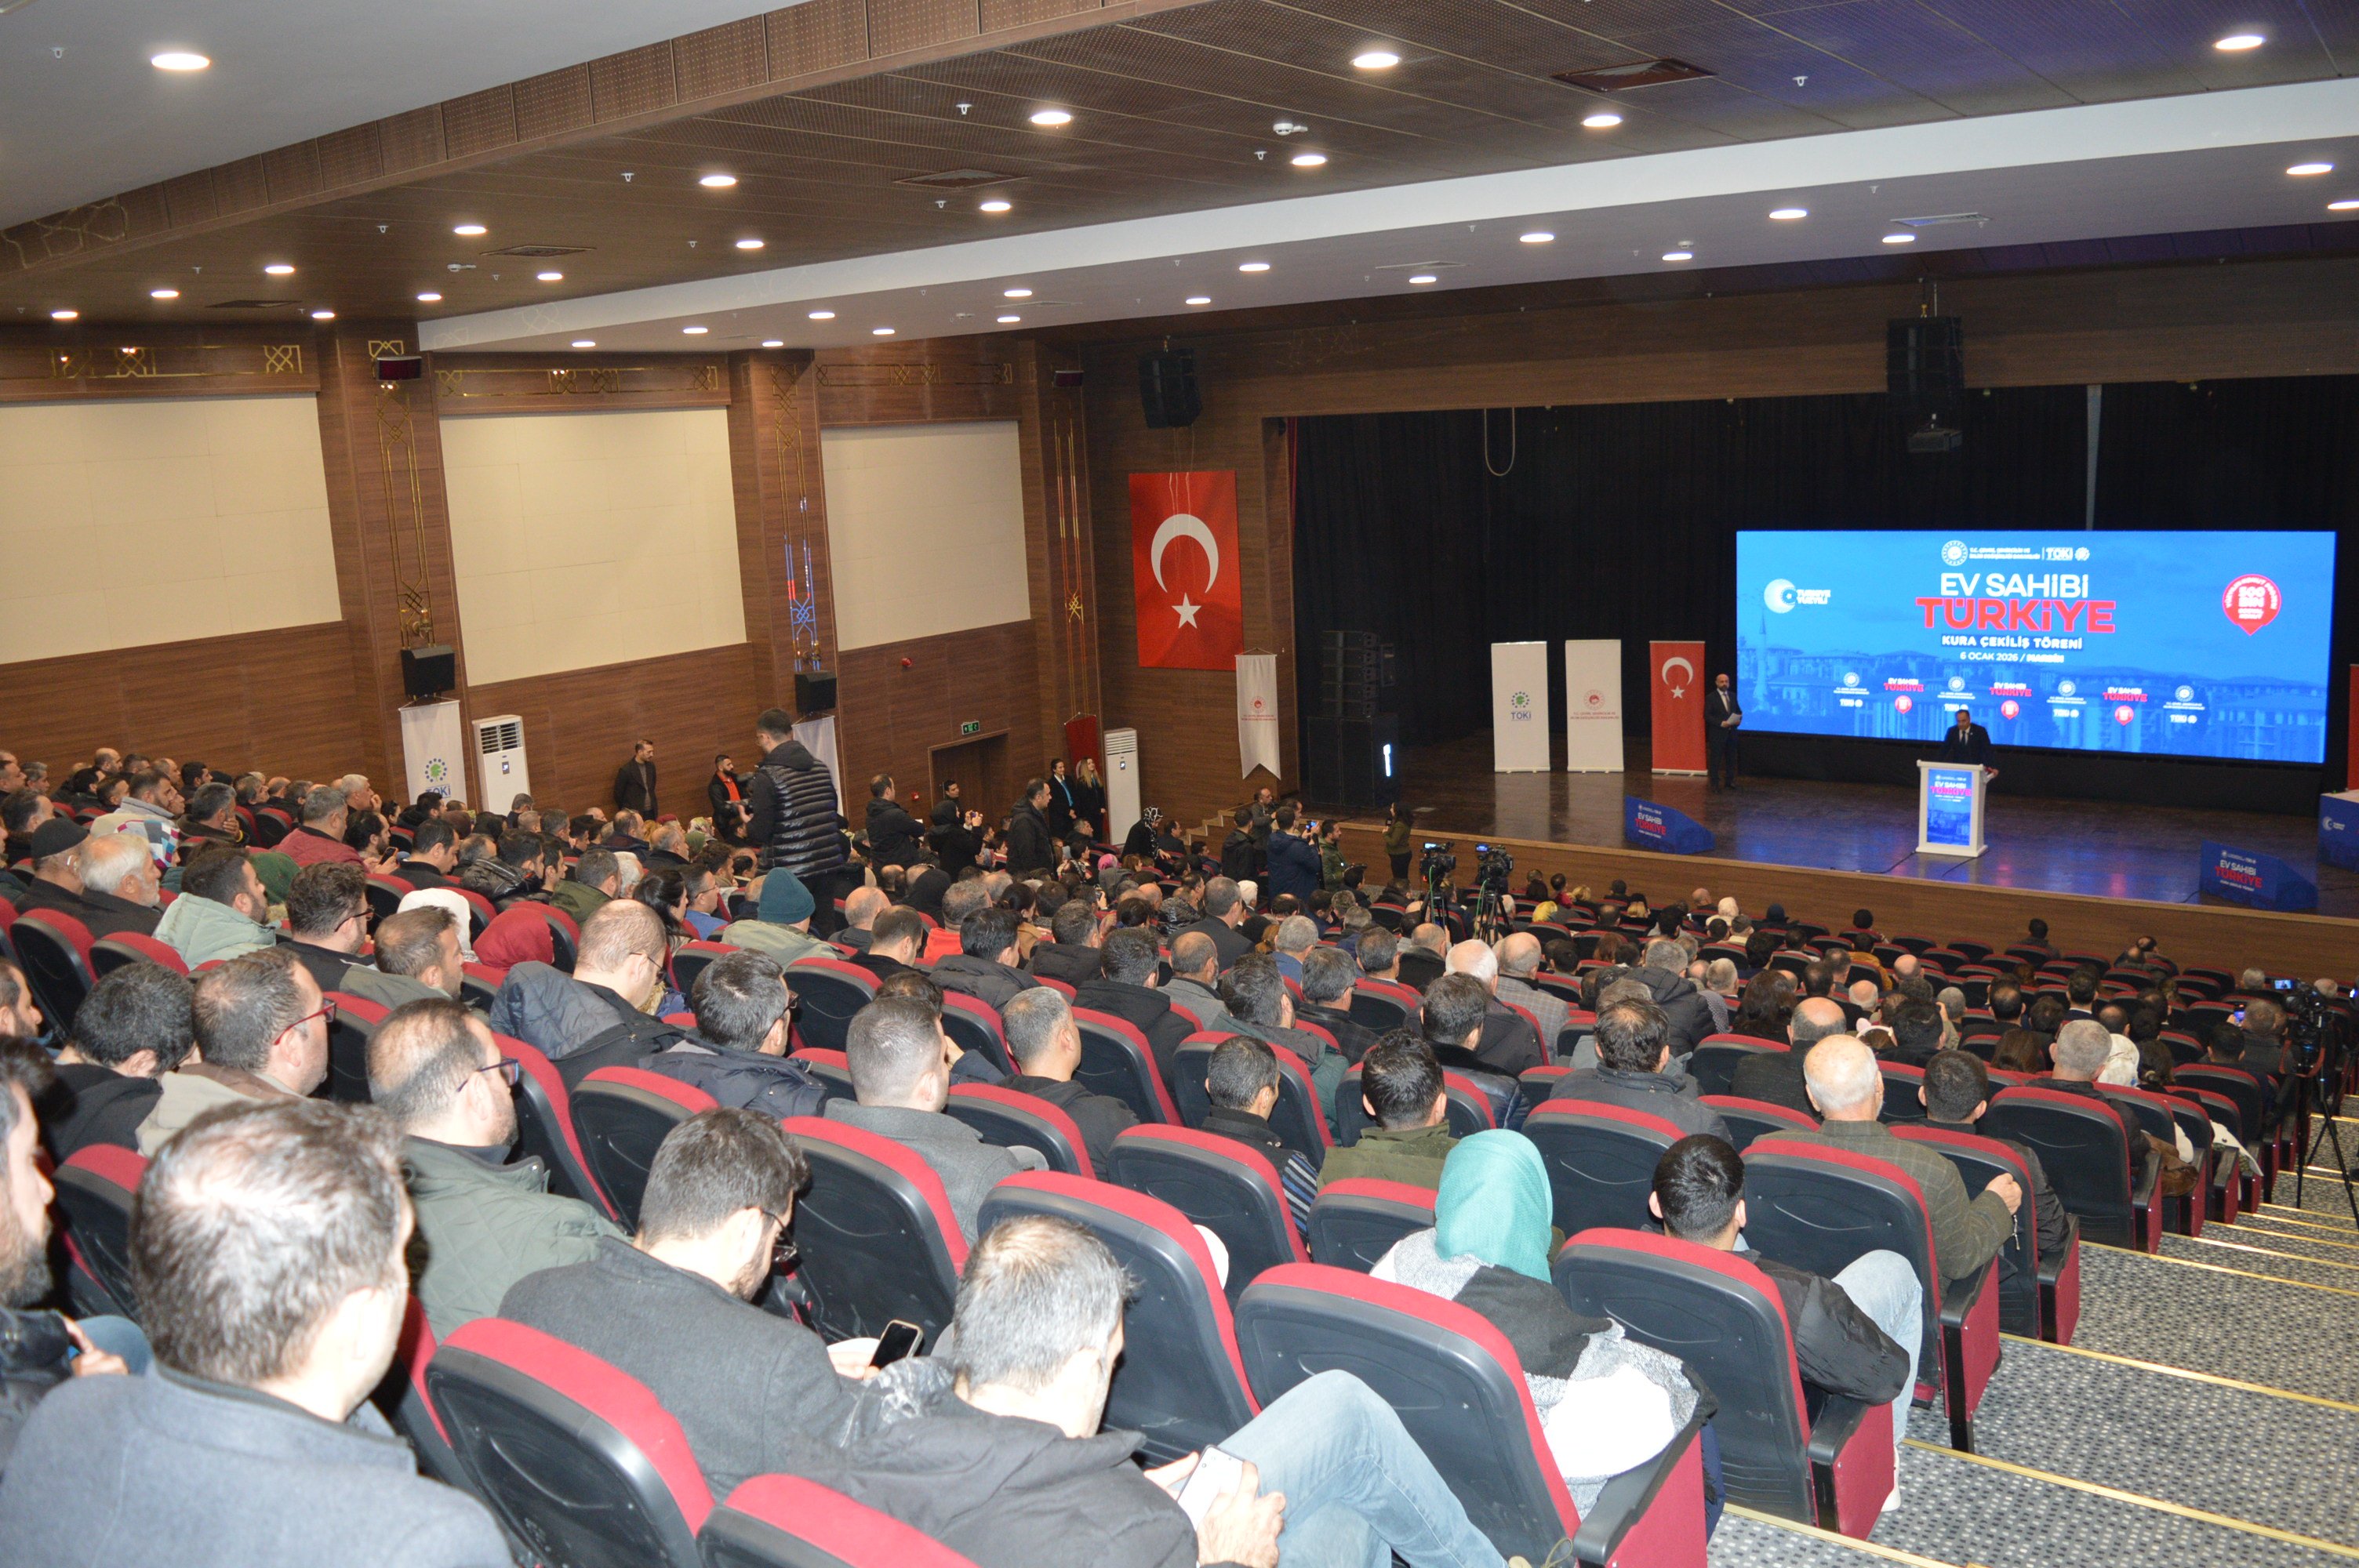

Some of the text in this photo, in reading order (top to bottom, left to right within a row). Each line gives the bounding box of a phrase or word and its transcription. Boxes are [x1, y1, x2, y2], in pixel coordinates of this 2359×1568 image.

[1940, 573, 2088, 598] EV SAHİBİ
[1915, 597, 2117, 633] TÜRKİYE
[1941, 635, 2082, 650] KURA ÇEKİLİŞ TÖRENİ
[1960, 652, 1967, 660] 6
[1968, 652, 1995, 661] OCAK
[1996, 652, 2019, 662] 2026
